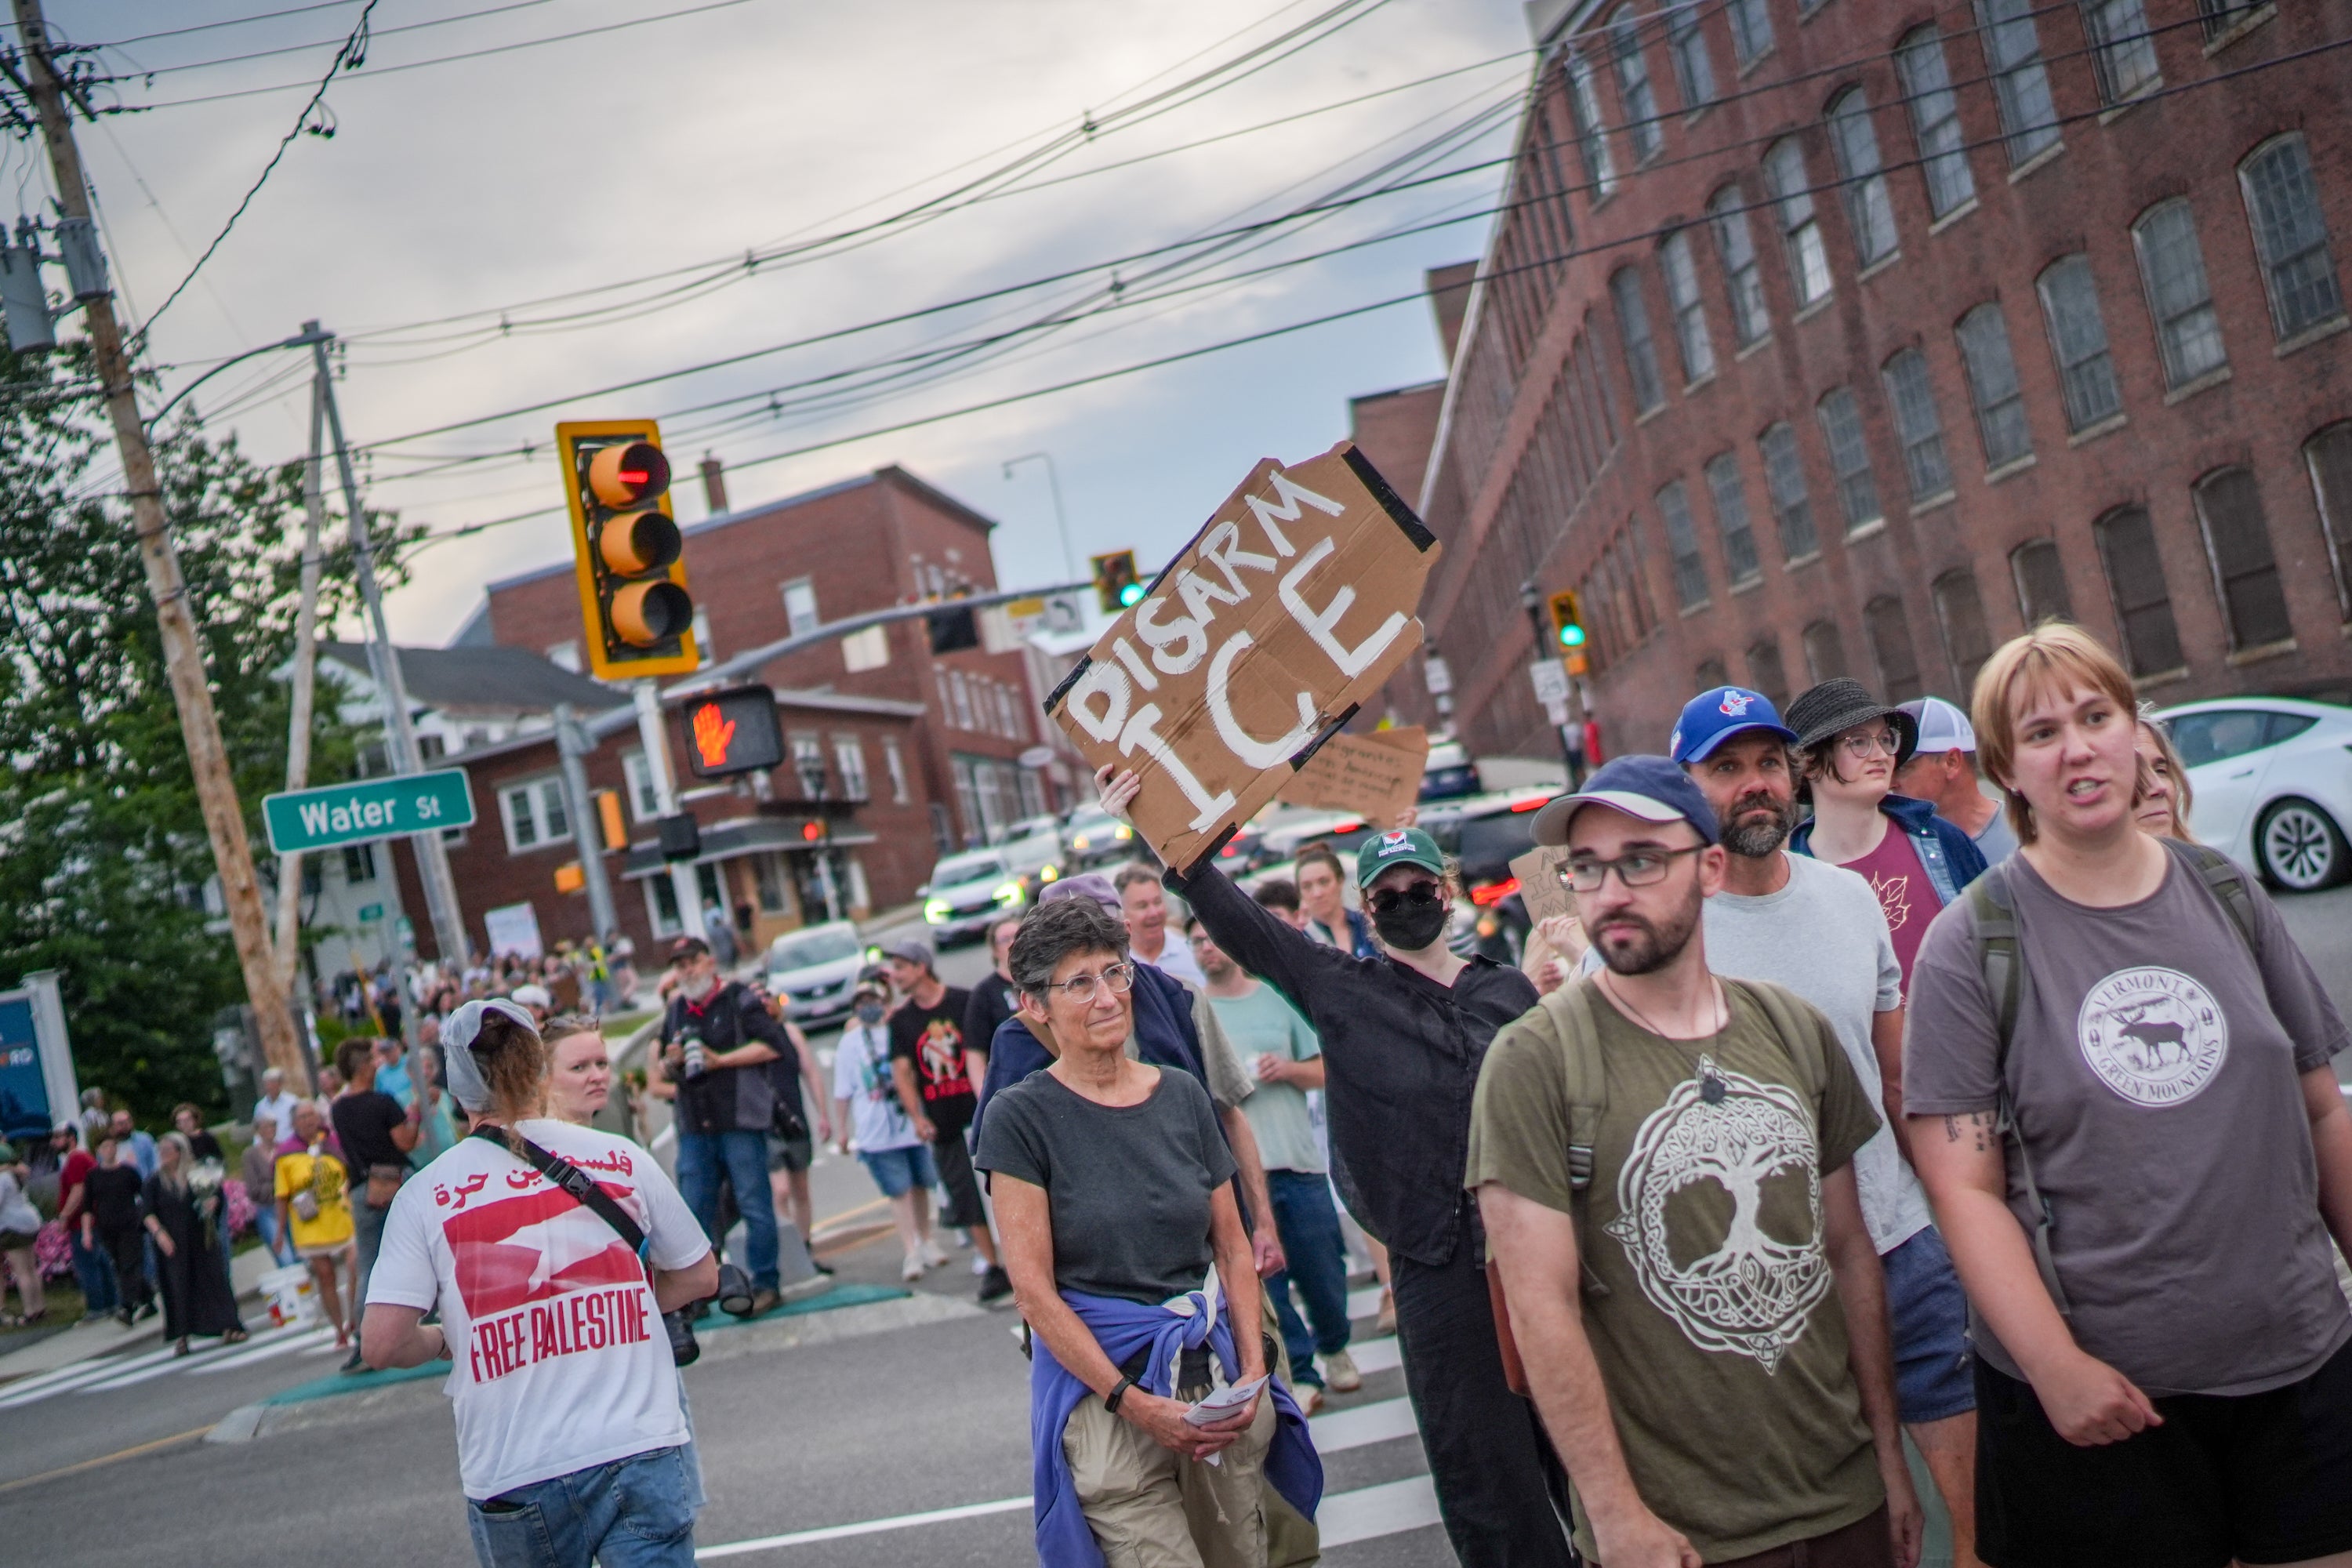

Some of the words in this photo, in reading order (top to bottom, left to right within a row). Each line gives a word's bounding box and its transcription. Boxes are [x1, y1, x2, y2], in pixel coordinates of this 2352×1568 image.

[1067, 470, 1345, 743] DISARM
[1119, 536, 1408, 834] ICE
[299, 797, 396, 837] Water
[416, 794, 441, 819] St
[2094, 974, 2183, 1008] VERMONT
[2099, 1058, 2145, 1096] GREEN
[2147, 1039, 2220, 1099] MOUNTAINS
[434, 1173, 488, 1210] حرة
[471, 1312, 526, 1384] FREE
[531, 1287, 650, 1363] PALESTINE
